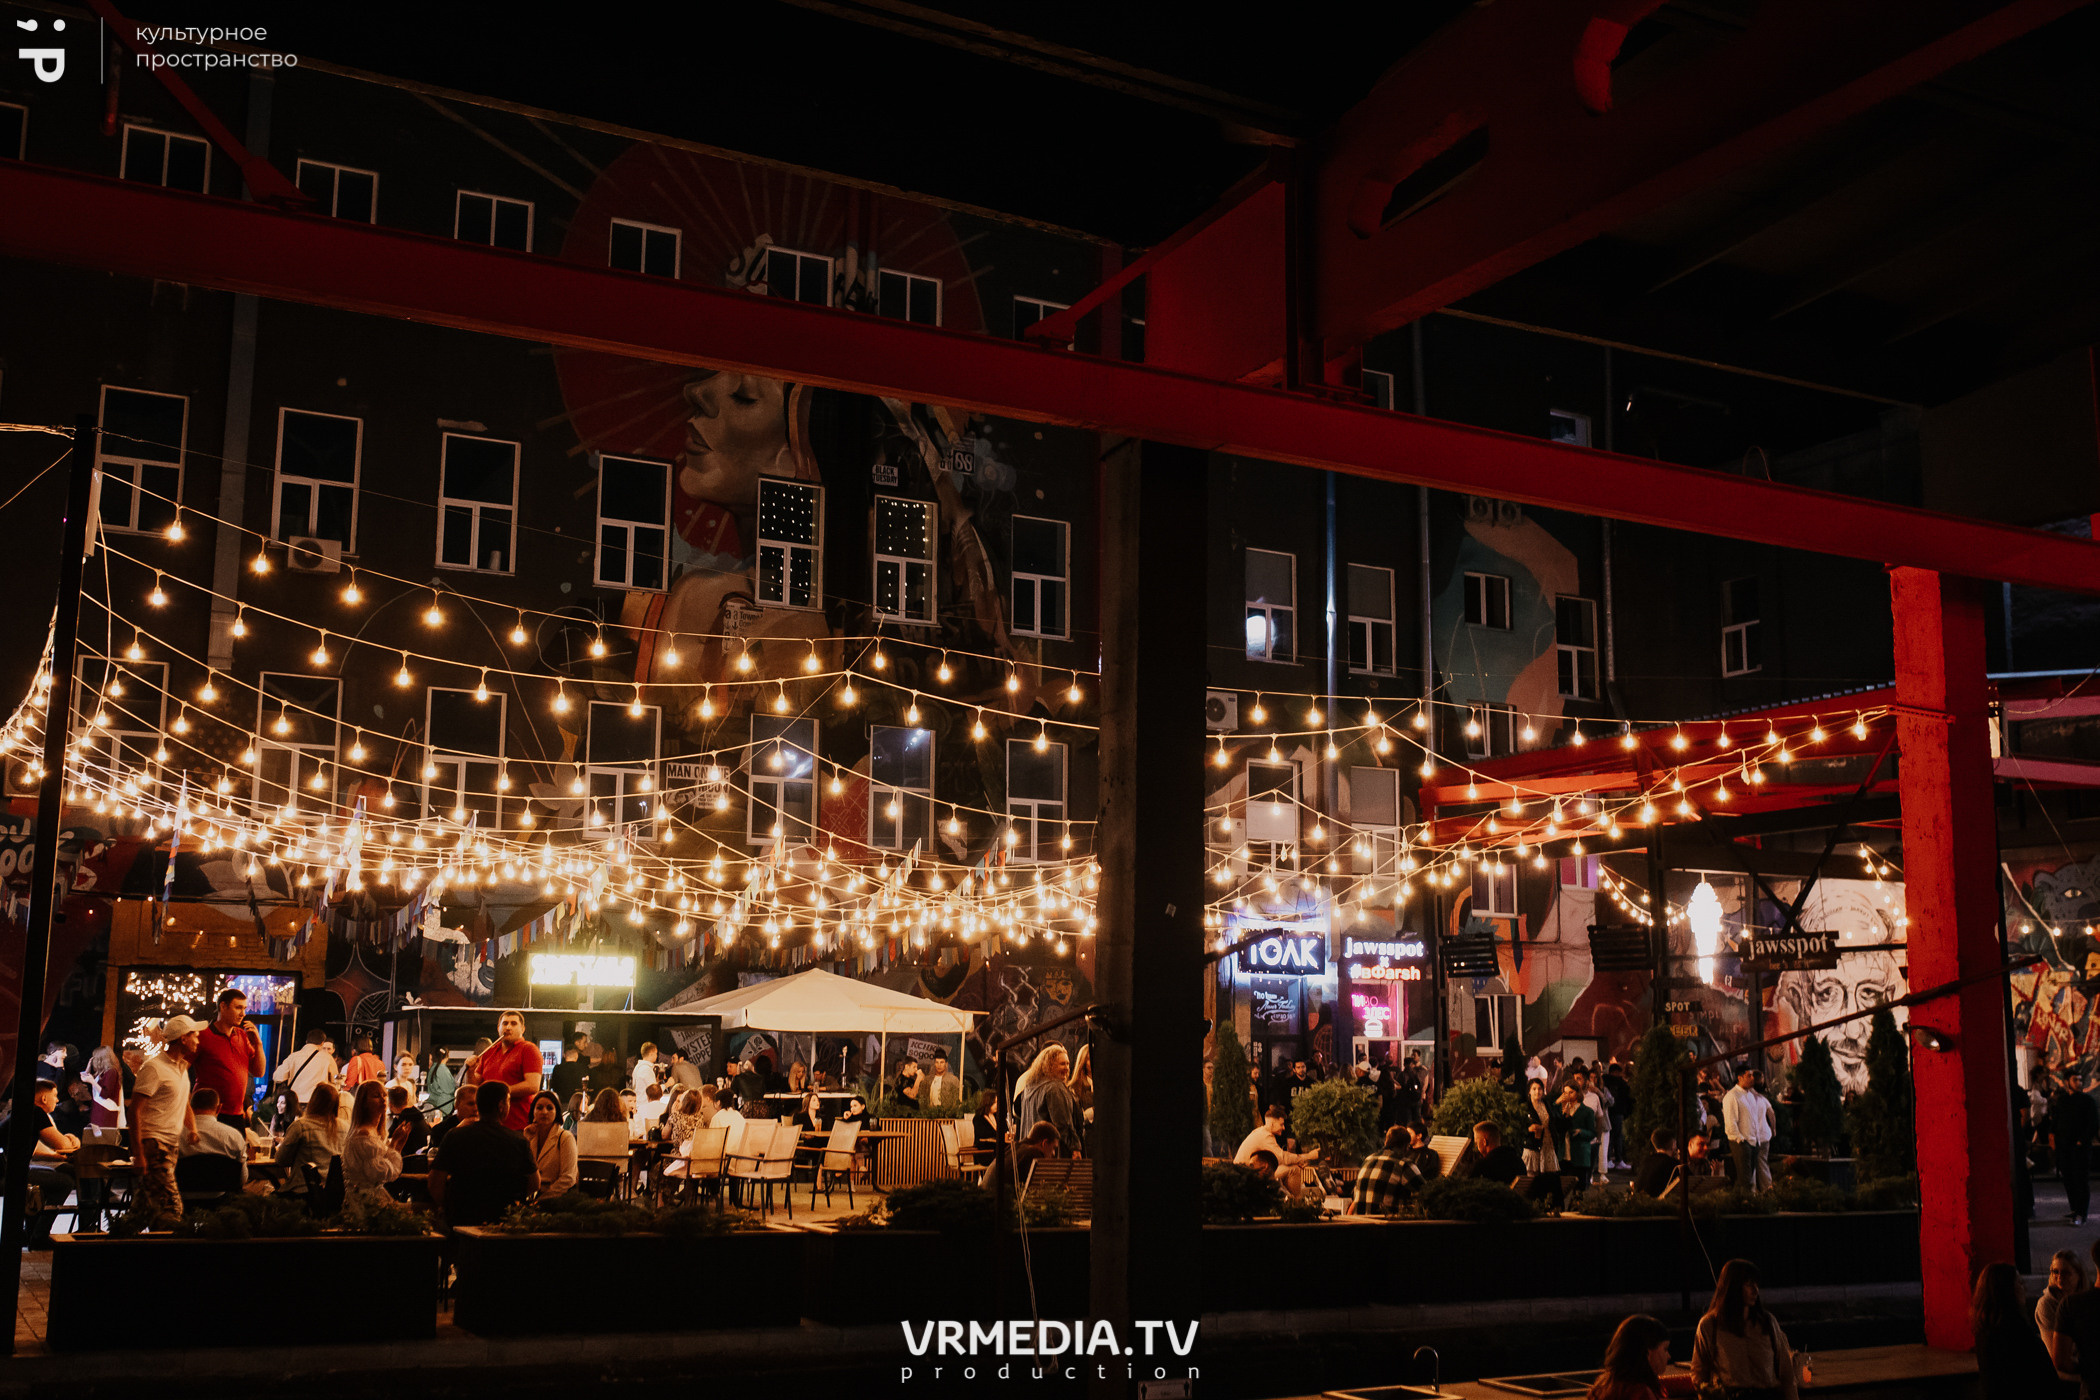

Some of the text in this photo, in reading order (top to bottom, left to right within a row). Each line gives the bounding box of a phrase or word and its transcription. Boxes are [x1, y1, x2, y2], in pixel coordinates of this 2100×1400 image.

[875, 465, 894, 475] BLACK
[872, 474, 896, 484] TUESDAY
[668, 764, 691, 778] MAN
[694, 766, 708, 779] ON
[1344, 936, 1425, 960] jawsspot
[1748, 933, 1829, 961] jawsspot
[1665, 1001, 1691, 1012] SPOT
